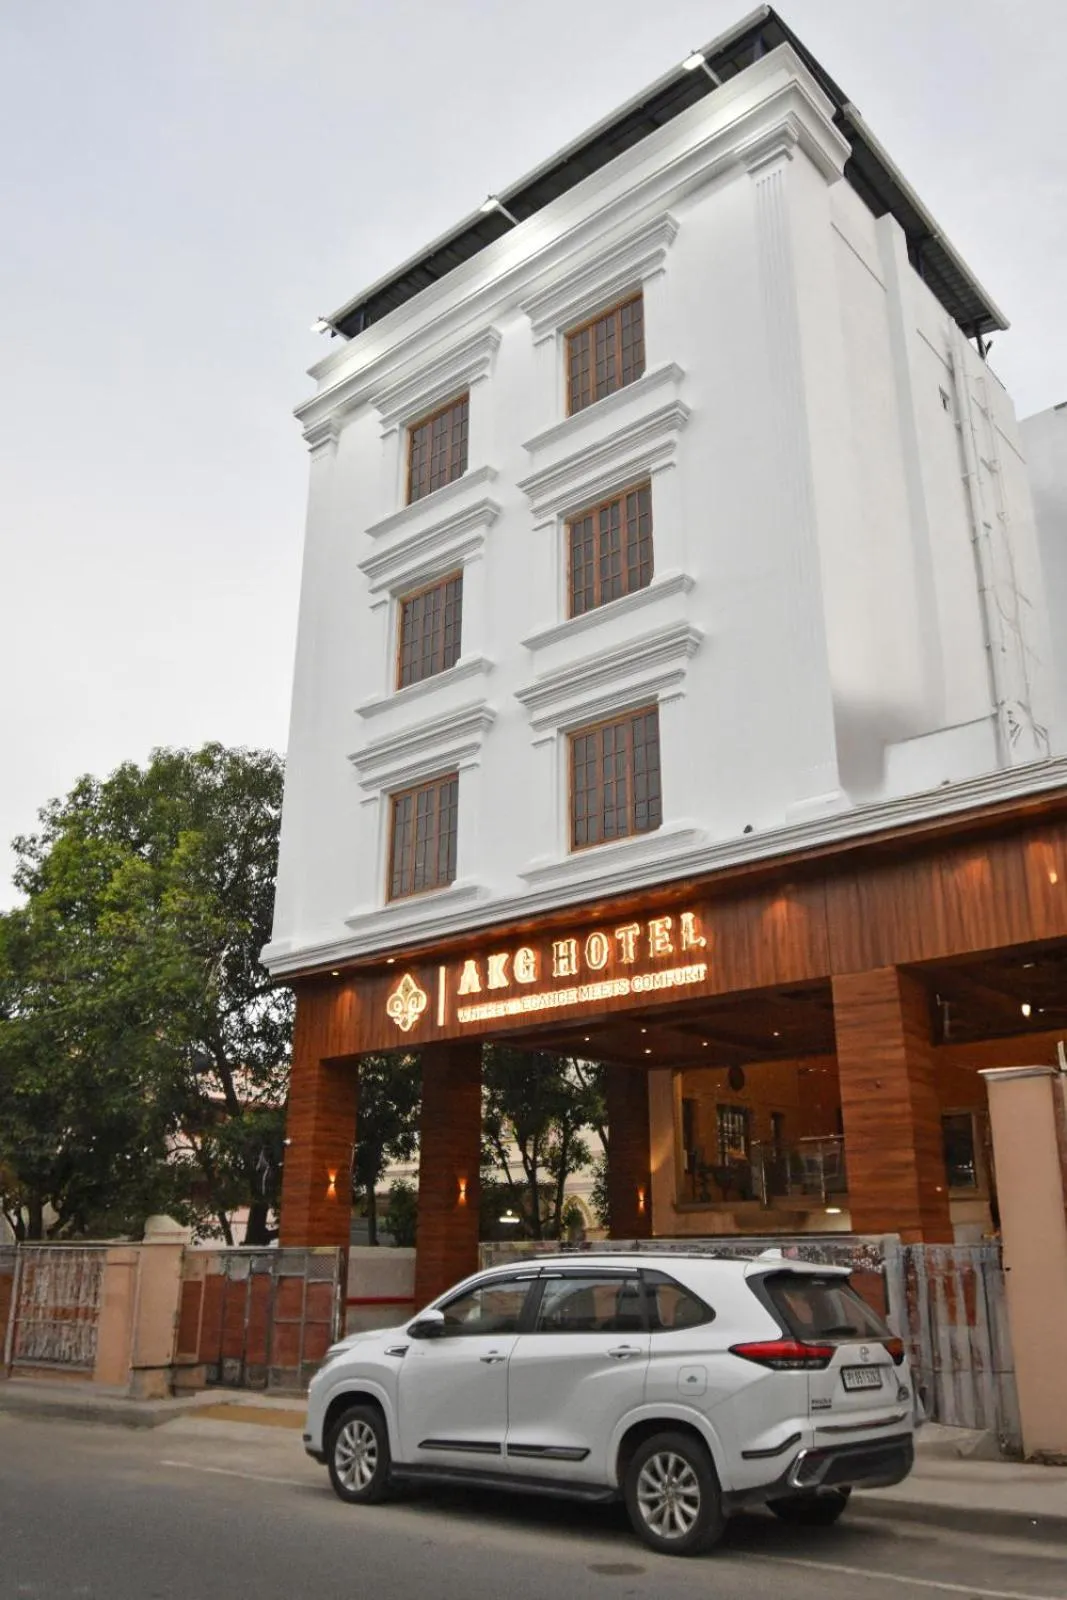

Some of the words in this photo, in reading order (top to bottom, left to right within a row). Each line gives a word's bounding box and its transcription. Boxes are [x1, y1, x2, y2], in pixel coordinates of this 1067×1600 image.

[457, 947, 537, 995] AKG
[552, 912, 707, 978] HOTEL
[507, 987, 578, 1016] EGANCE
[578, 978, 630, 1003] MEETS
[631, 963, 707, 992] COMFORT
